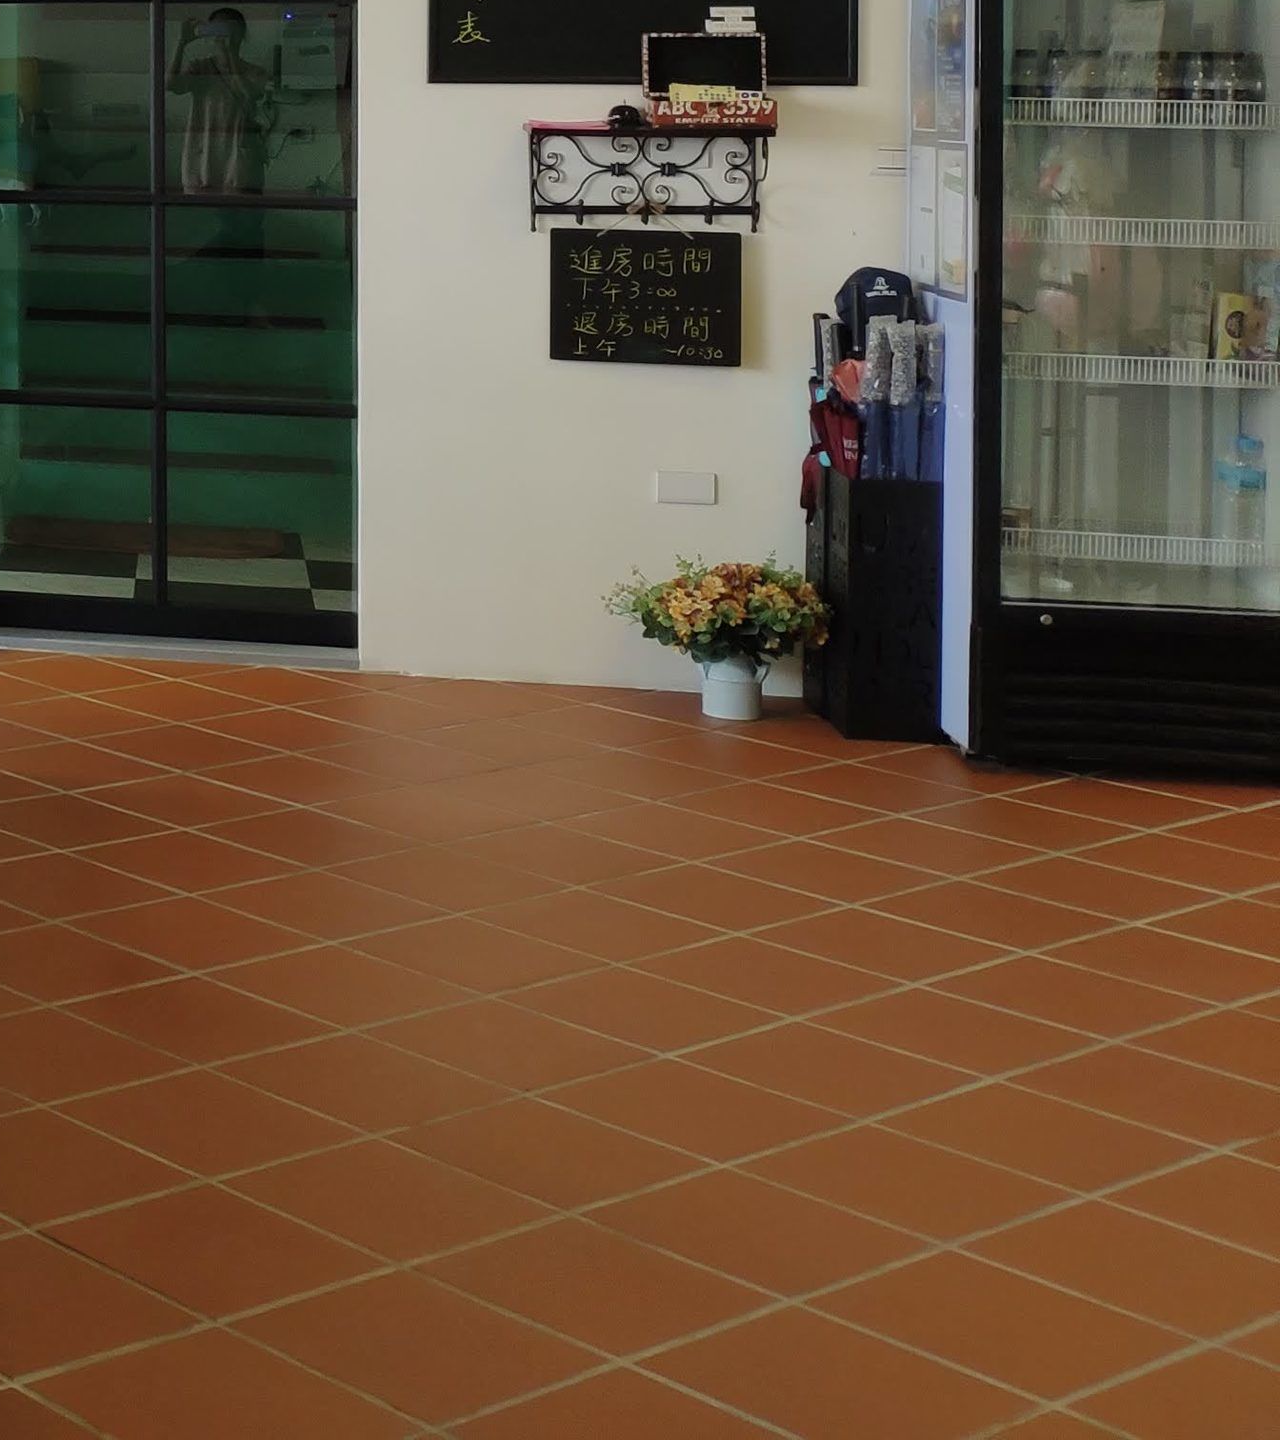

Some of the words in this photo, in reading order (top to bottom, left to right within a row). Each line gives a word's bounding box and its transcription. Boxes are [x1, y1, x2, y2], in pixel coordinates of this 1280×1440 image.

[657, 100, 698, 116] ABC
[569, 244, 712, 277] 進房時間
[573, 311, 710, 342] 退房時間
[573, 336, 617, 358] 上午
